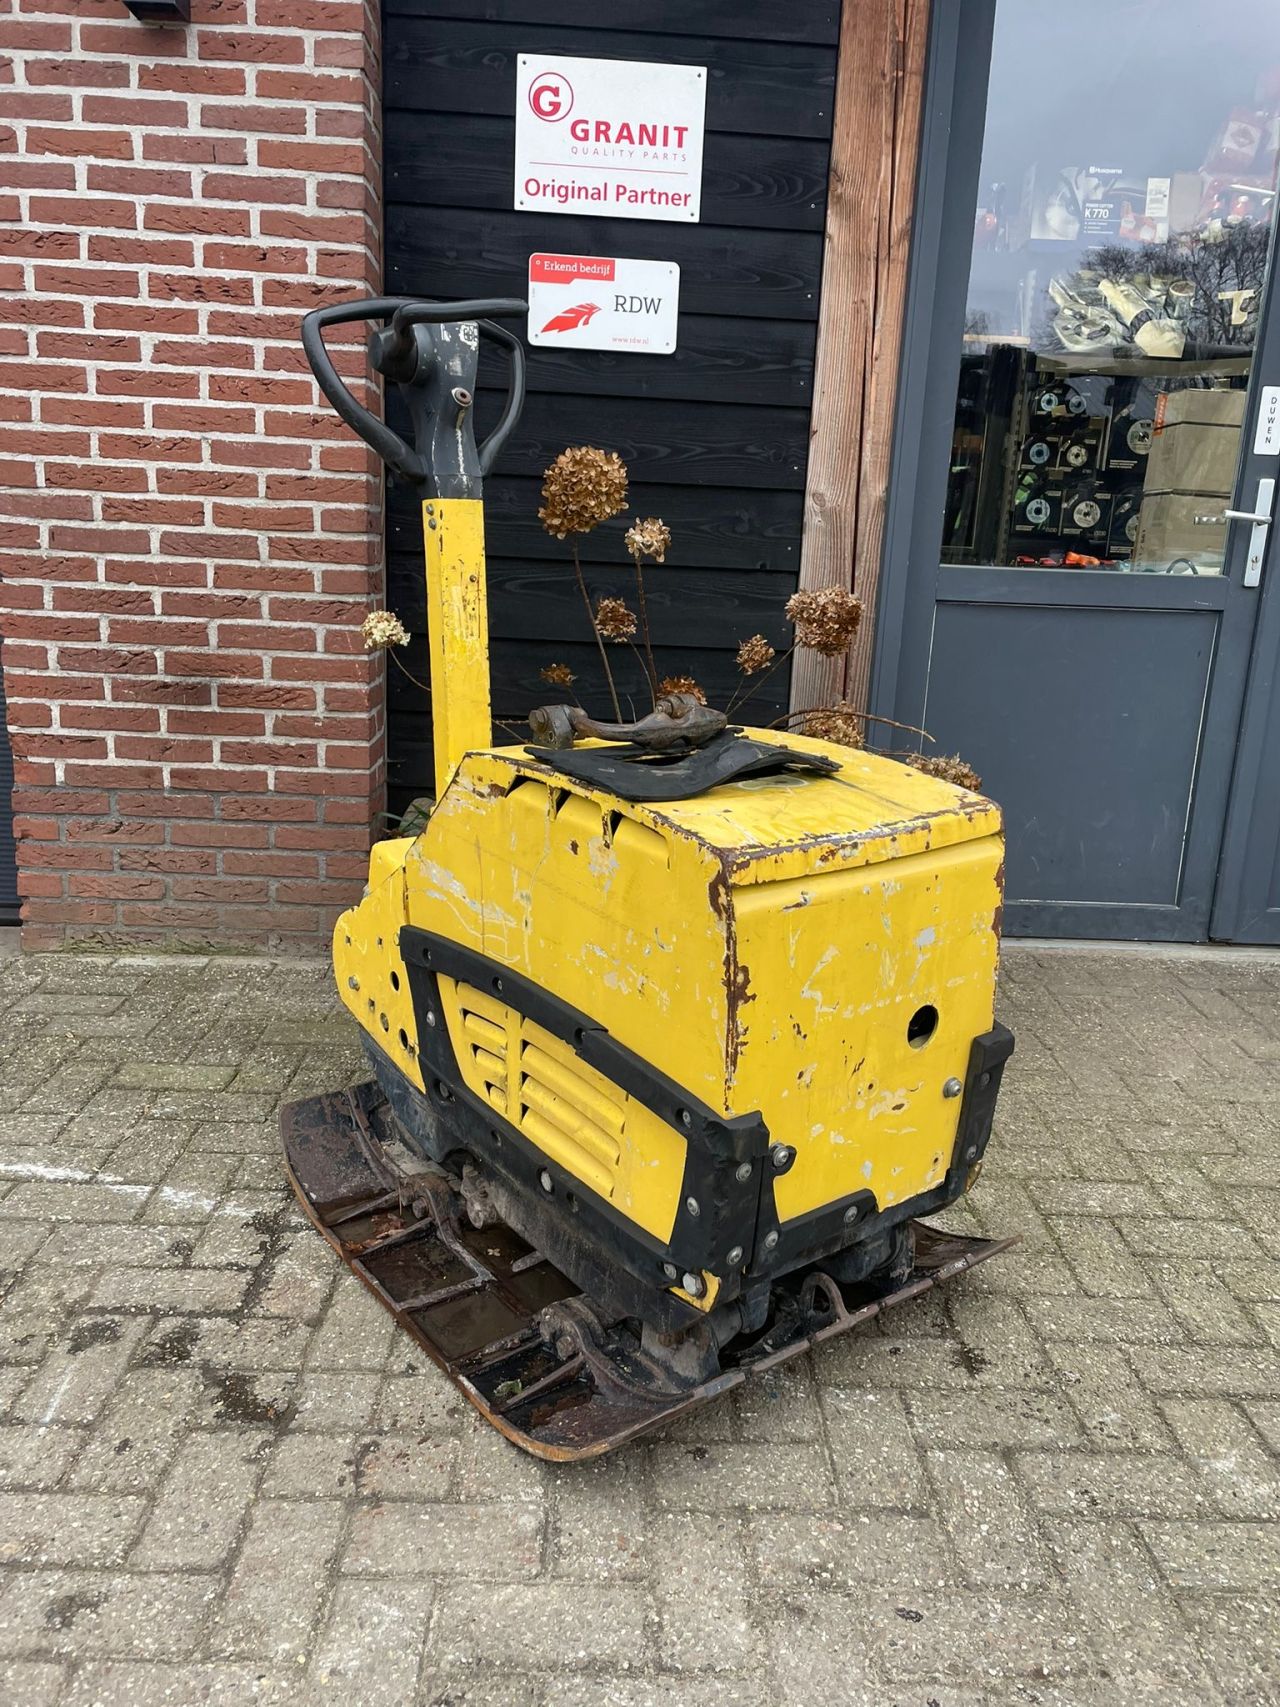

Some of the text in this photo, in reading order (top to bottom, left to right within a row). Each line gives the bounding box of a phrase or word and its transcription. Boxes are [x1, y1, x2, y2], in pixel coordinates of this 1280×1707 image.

[532, 85, 562, 117] G
[570, 119, 689, 149] GRANIT
[571, 146, 687, 162] QUALITY PARTS
[524, 178, 692, 207] Original Partner
[1092, 208, 1109, 219] 770
[544, 260, 610, 277] Erkend bedrijf
[614, 294, 662, 315] RDW
[1265, 396, 1278, 444] DUWEN
